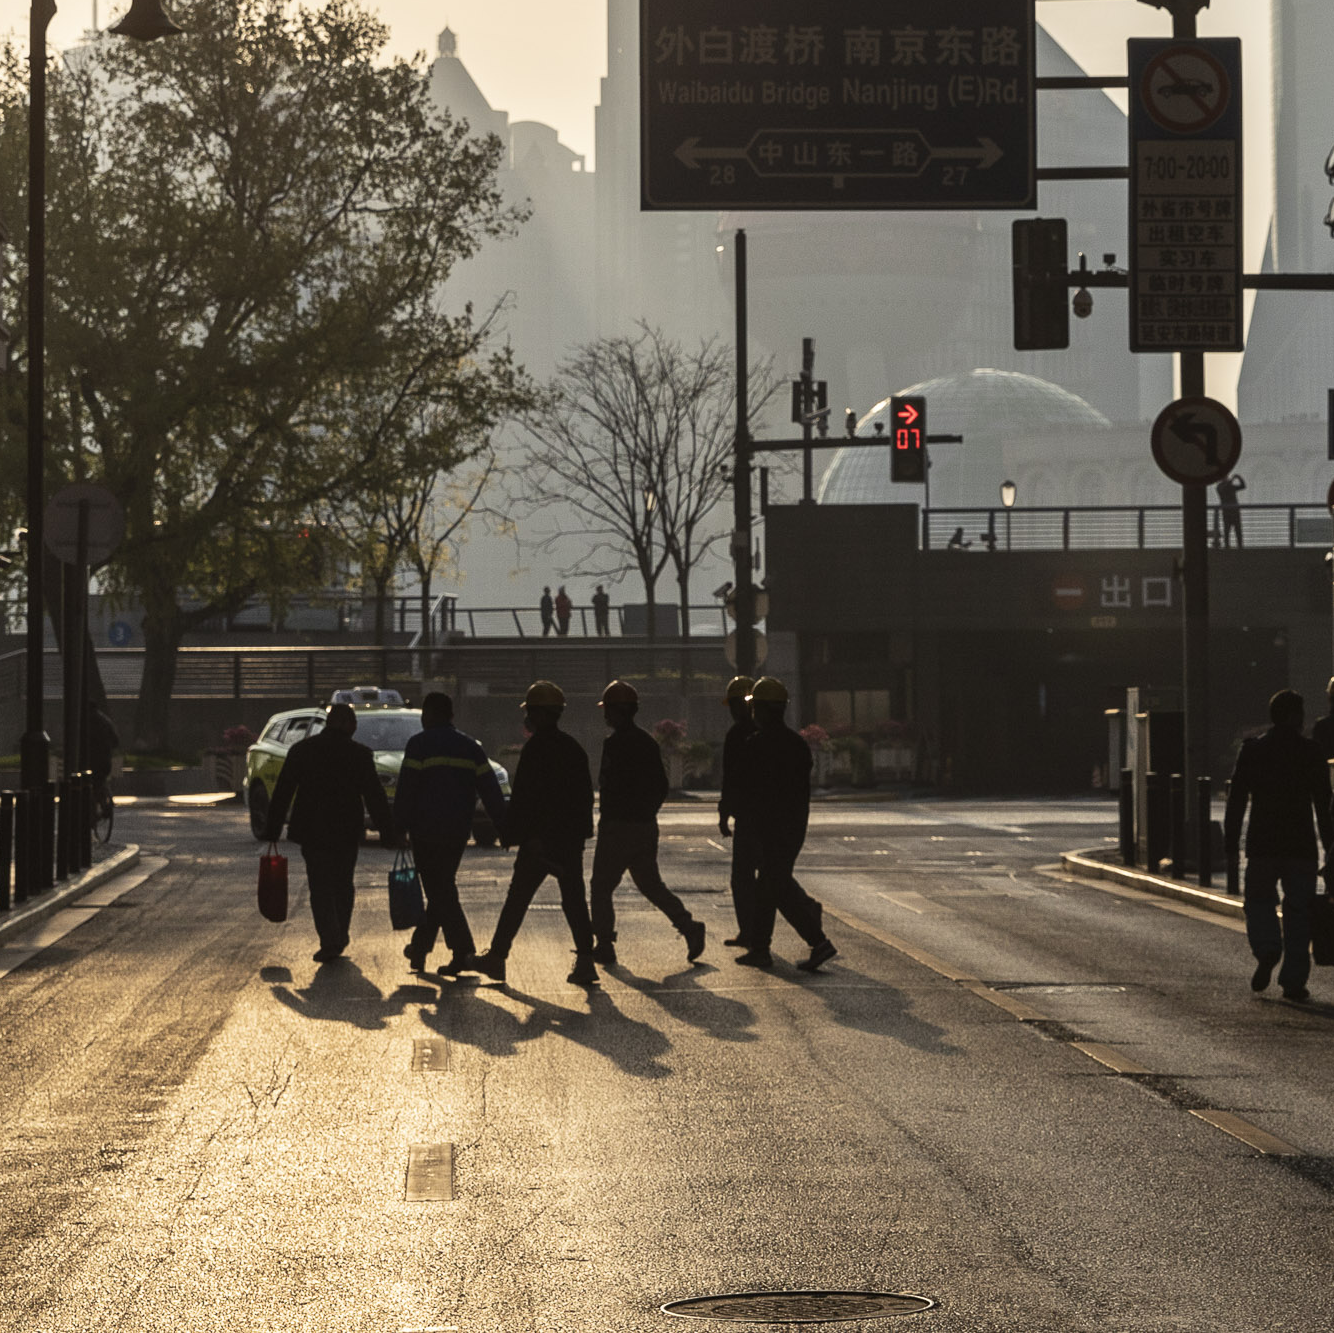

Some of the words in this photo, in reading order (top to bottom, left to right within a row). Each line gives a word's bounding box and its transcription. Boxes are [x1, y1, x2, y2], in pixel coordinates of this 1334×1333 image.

[654, 25, 825, 66] 外白渡桥
[841, 24, 1022, 67] 南京东路
[659, 80, 754, 104] Waibaidu
[762, 81, 831, 111] Bridge
[842, 77, 938, 111] Nanjing
[758, 140, 919, 167] 中山东一路
[709, 165, 736, 185] 28
[941, 165, 969, 186] 27
[1144, 155, 1230, 180] 7:00-20:00
[896, 428, 921, 450] 07
[1100, 574, 1172, 608] 出口
